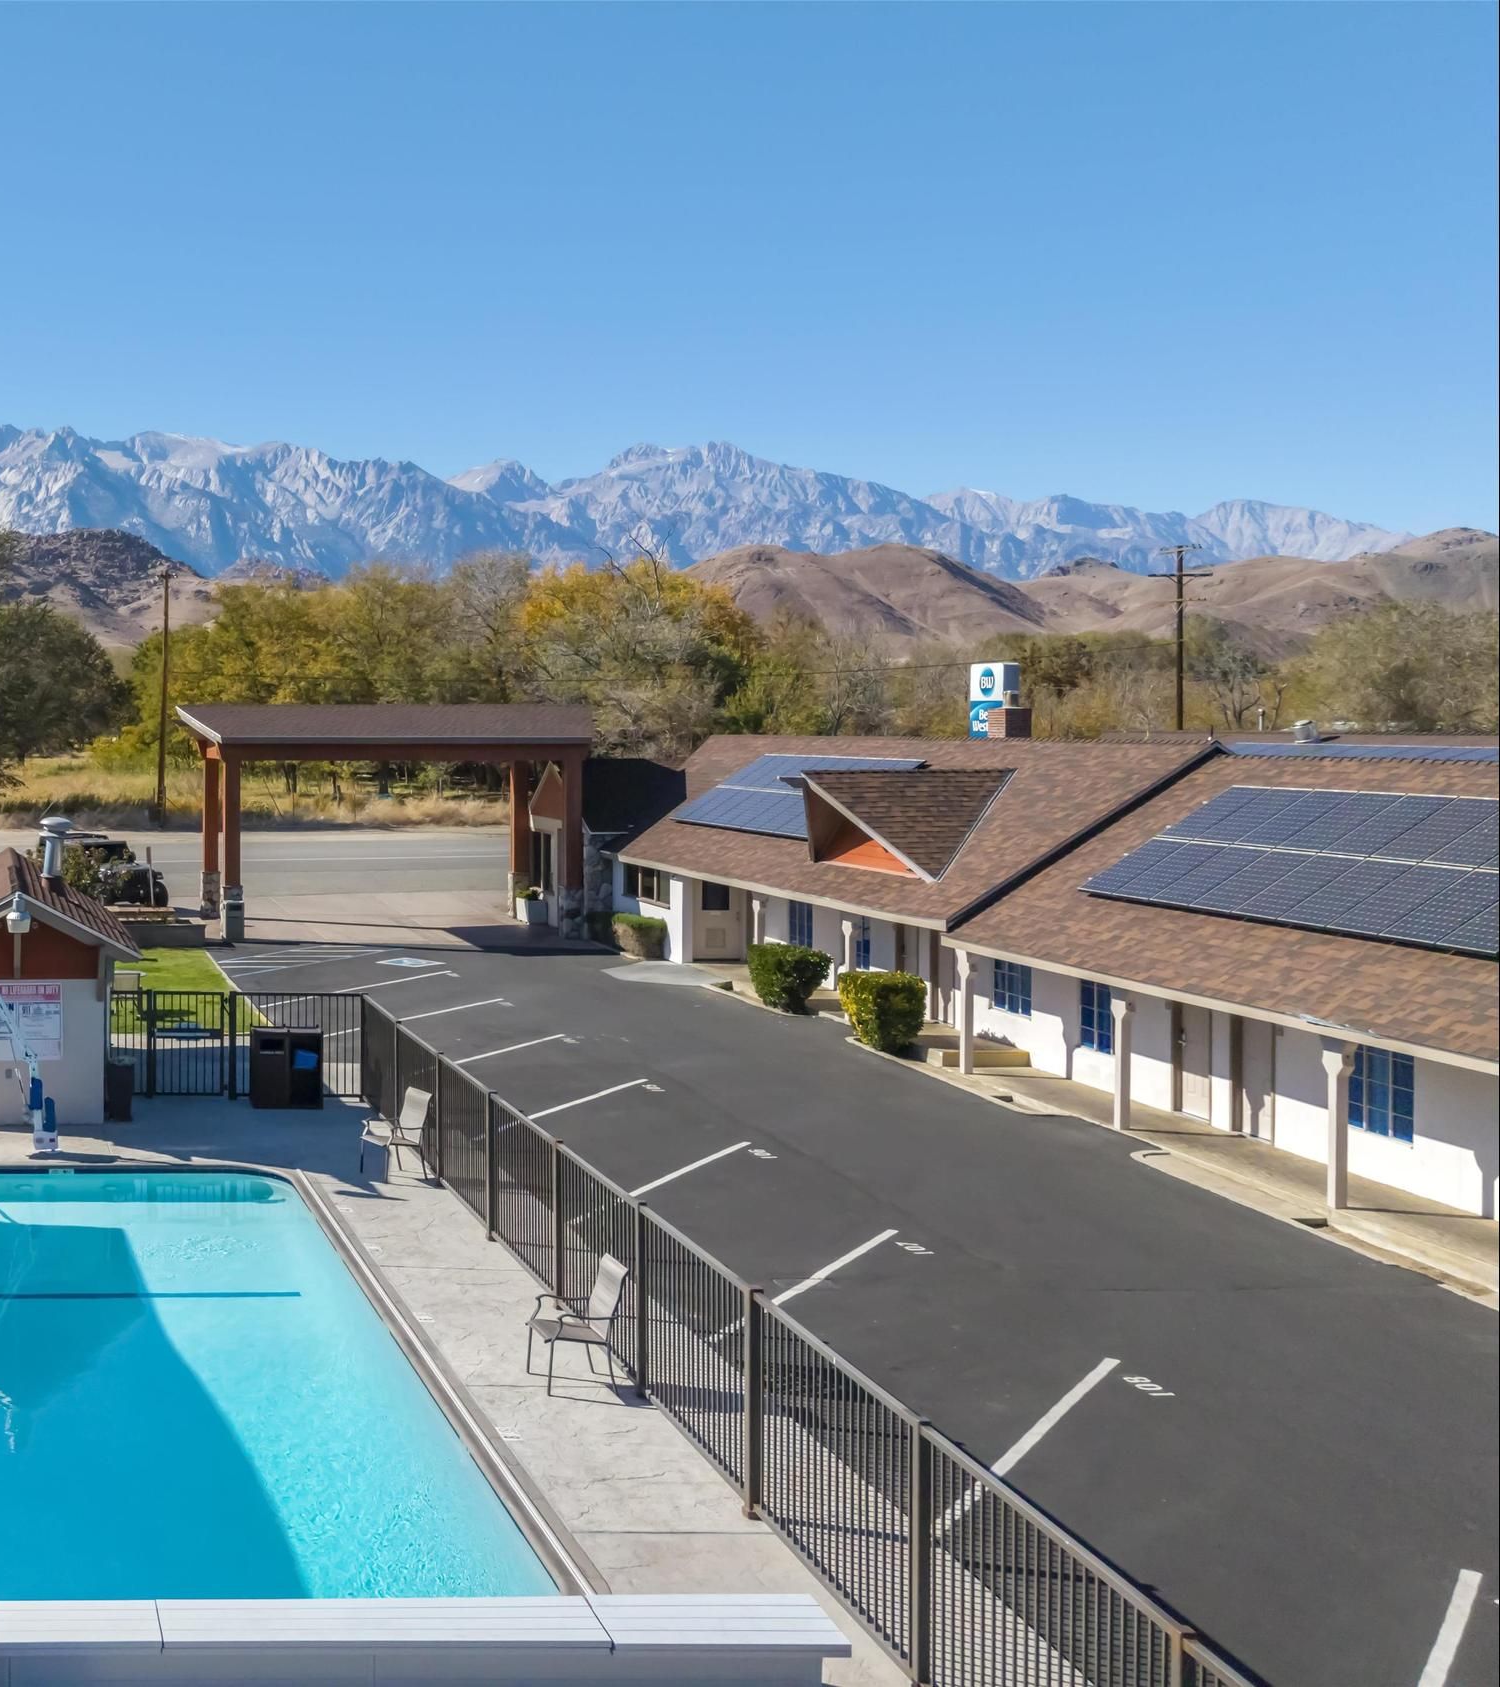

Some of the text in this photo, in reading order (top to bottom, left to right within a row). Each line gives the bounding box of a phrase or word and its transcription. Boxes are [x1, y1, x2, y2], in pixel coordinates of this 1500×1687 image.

[980, 676, 994, 688] BW
[979, 709, 988, 720] Be
[972, 720, 988, 732] West
